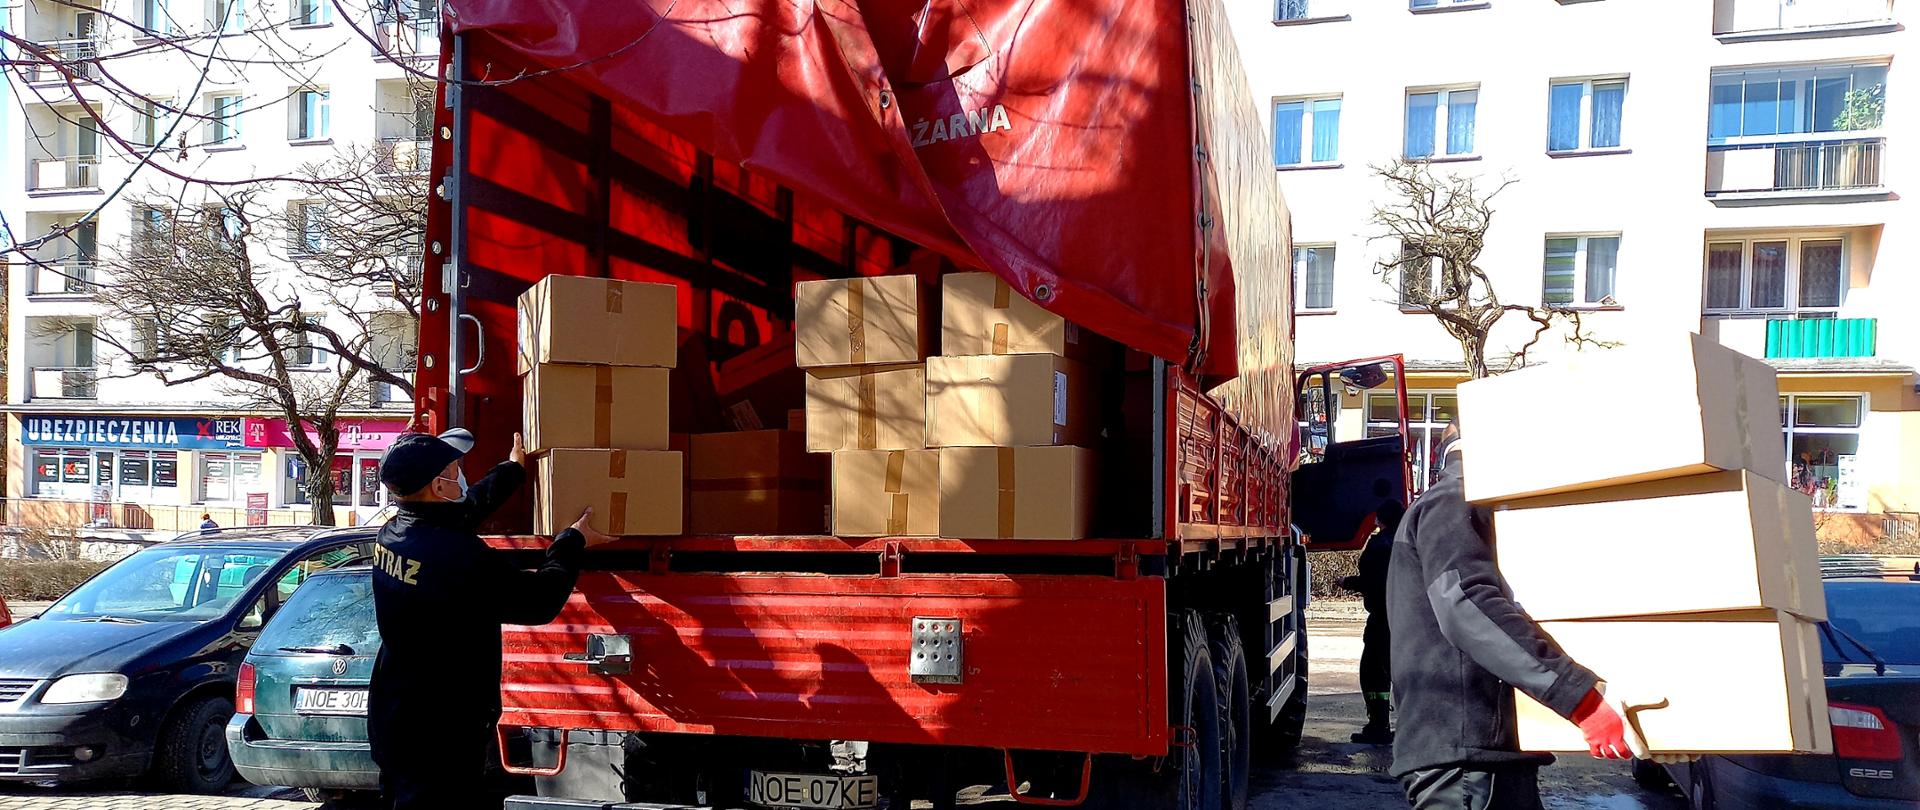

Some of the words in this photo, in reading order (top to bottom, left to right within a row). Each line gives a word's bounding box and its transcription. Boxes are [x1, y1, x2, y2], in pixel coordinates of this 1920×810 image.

[907, 104, 1012, 148] ŻARNA
[28, 418, 180, 444] UBEZPIECZENIA
[215, 420, 241, 434] REK
[304, 690, 339, 708] NOE
[1849, 767, 1894, 780] 626
[752, 773, 801, 804] NOE
[810, 779, 874, 807] 07KE
